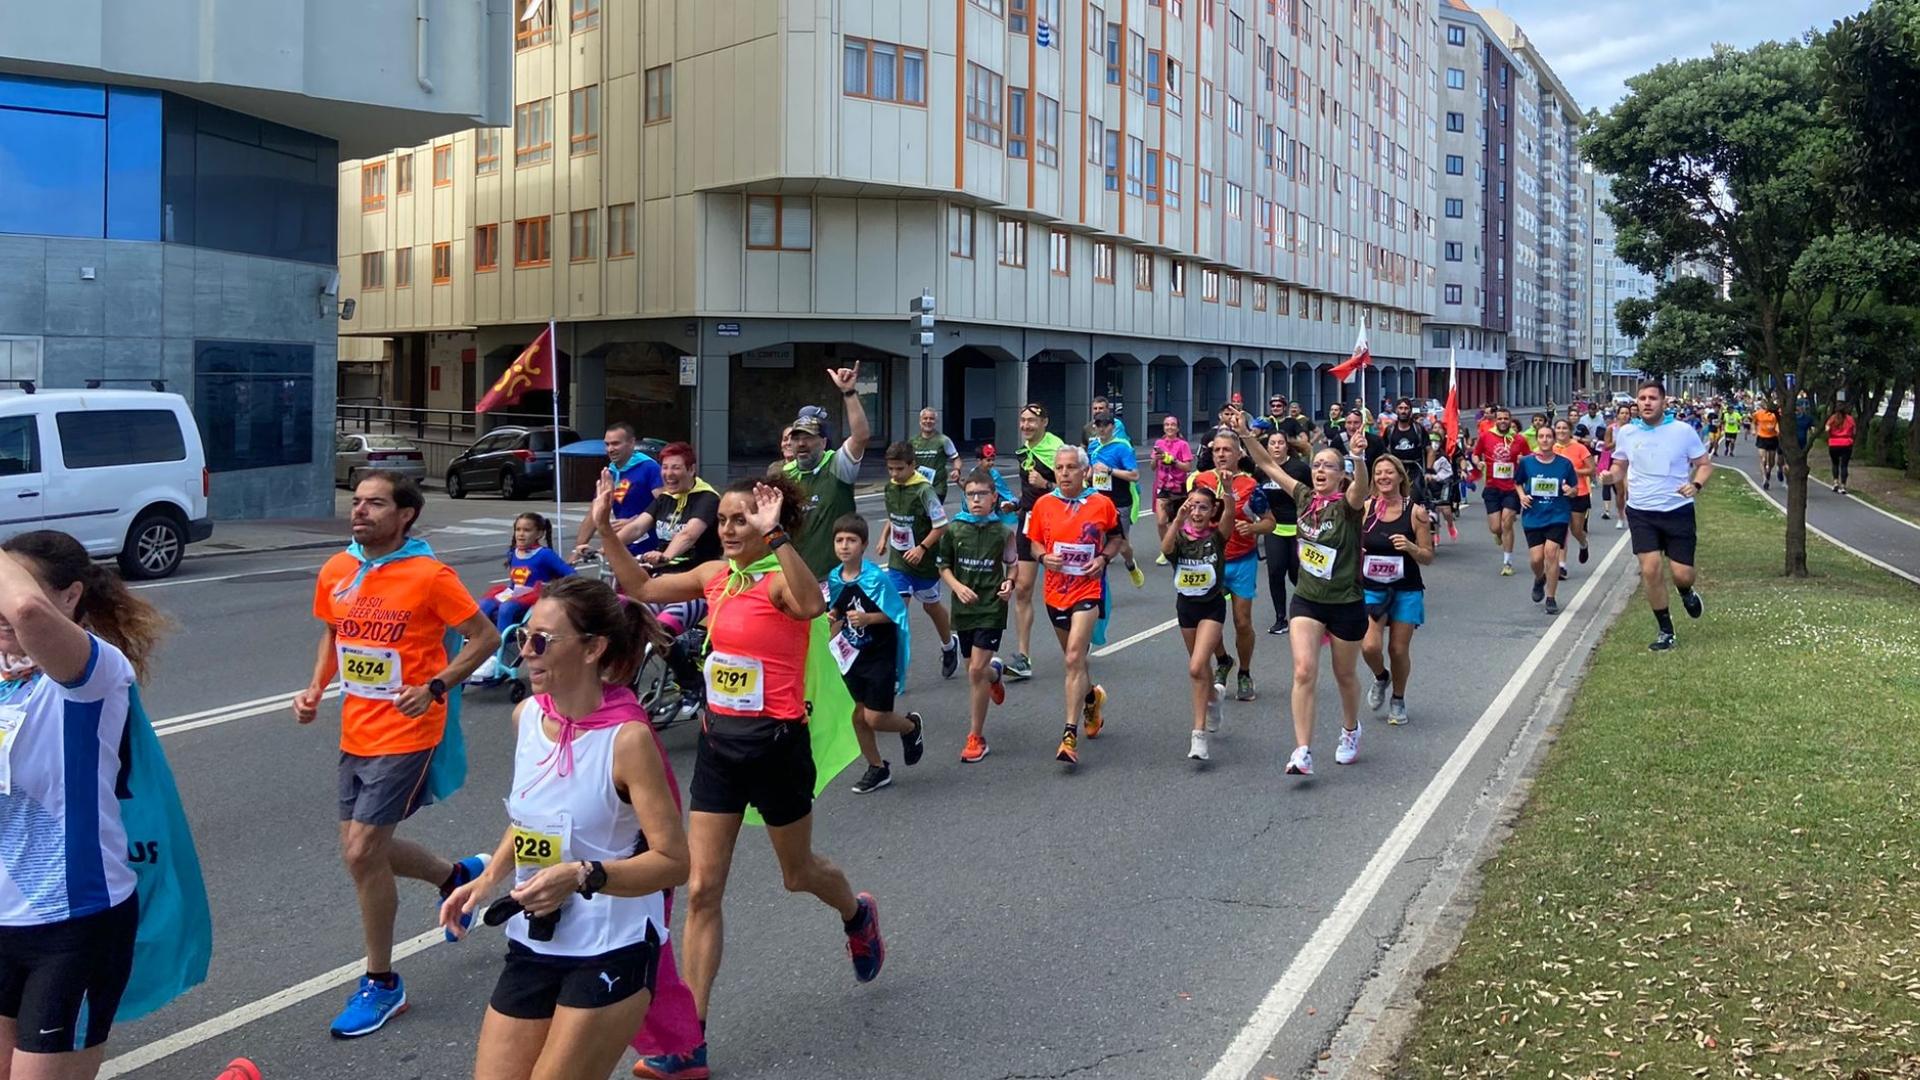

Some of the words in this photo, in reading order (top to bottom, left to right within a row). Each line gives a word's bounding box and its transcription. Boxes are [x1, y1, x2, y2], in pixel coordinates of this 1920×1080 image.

[1305, 548, 1325, 564] 3572
[1371, 564, 1395, 573] 3770
[1182, 574, 1207, 583] 3573
[355, 596, 368, 607] YO
[367, 597, 385, 608] SOY
[348, 607, 372, 618] BEER
[372, 609, 413, 621] RUNNER
[361, 621, 408, 643] 2020
[347, 659, 385, 677] 2674
[716, 669, 749, 687] 2791
[514, 835, 552, 858] 928
